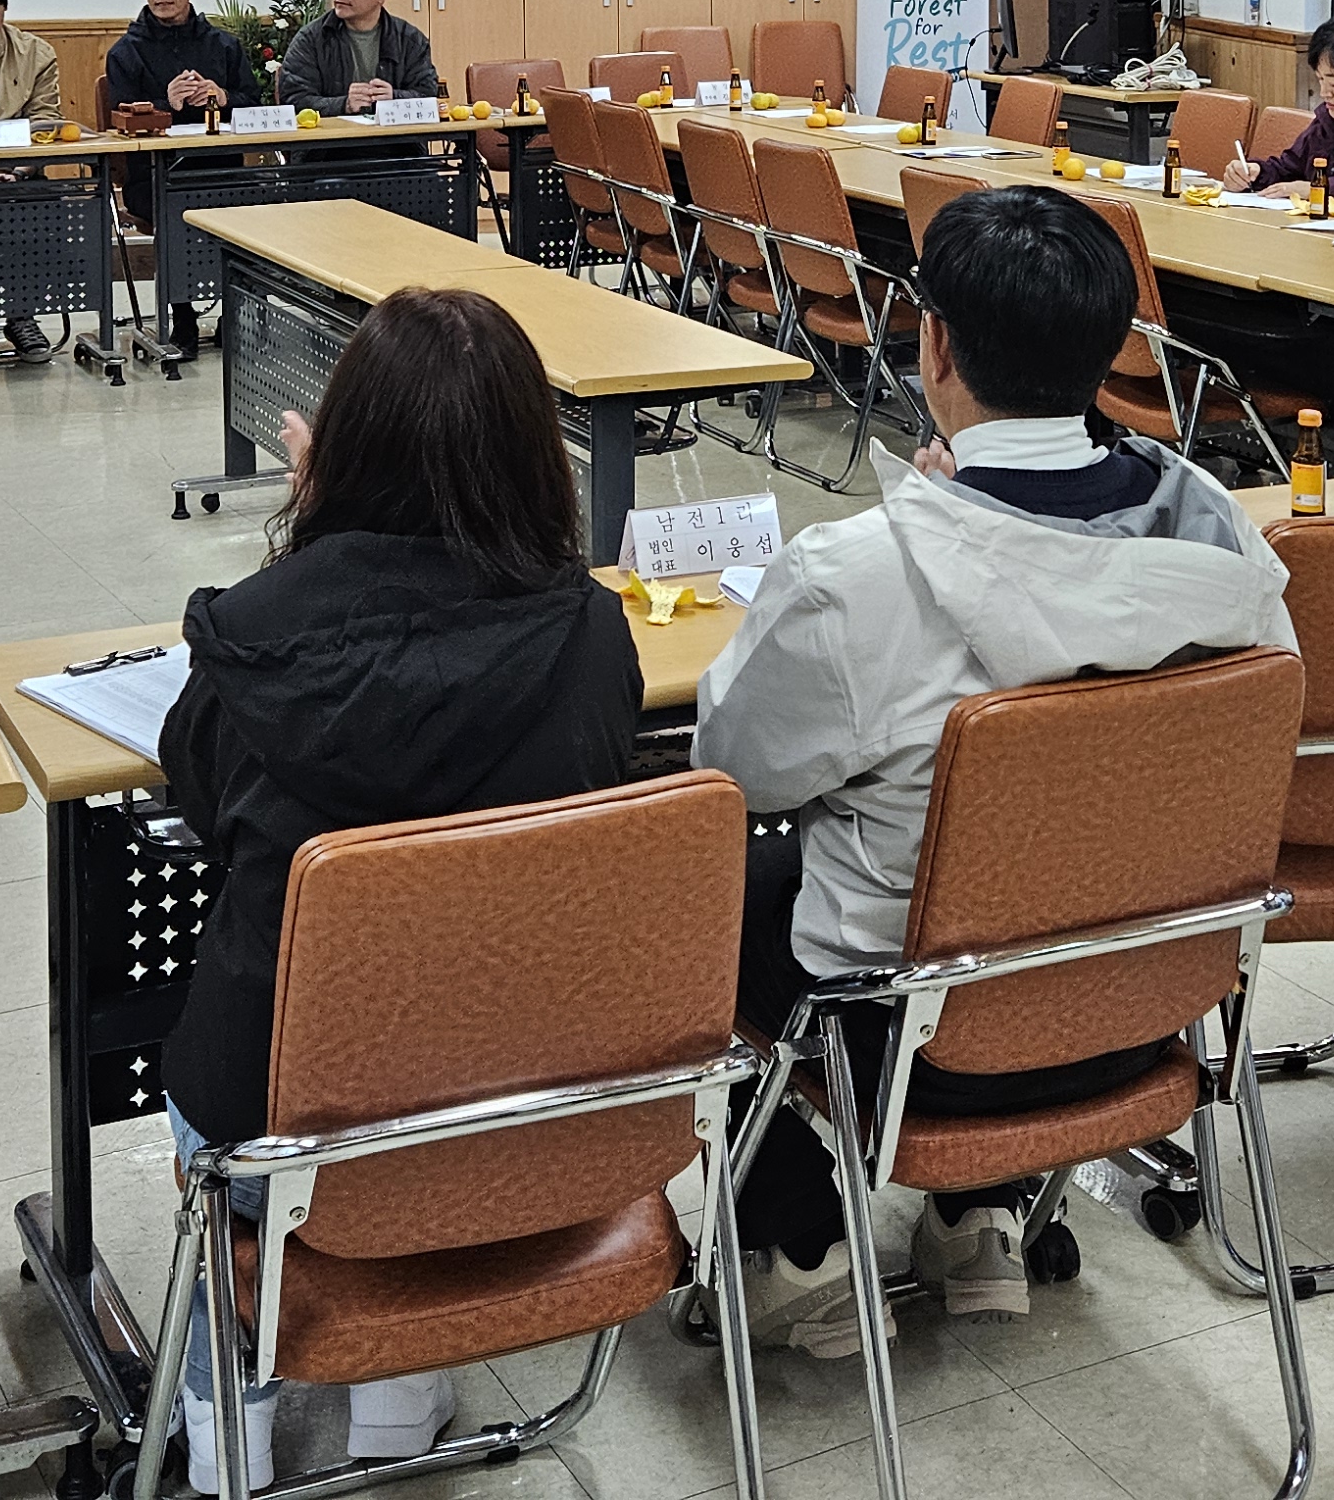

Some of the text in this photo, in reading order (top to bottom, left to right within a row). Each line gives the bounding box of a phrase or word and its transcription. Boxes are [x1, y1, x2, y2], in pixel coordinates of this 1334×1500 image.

[915, 16, 943, 36] for
[883, 18, 970, 70] Rest
[648, 537, 674, 555] 법인
[651, 559, 677, 575] 대표
